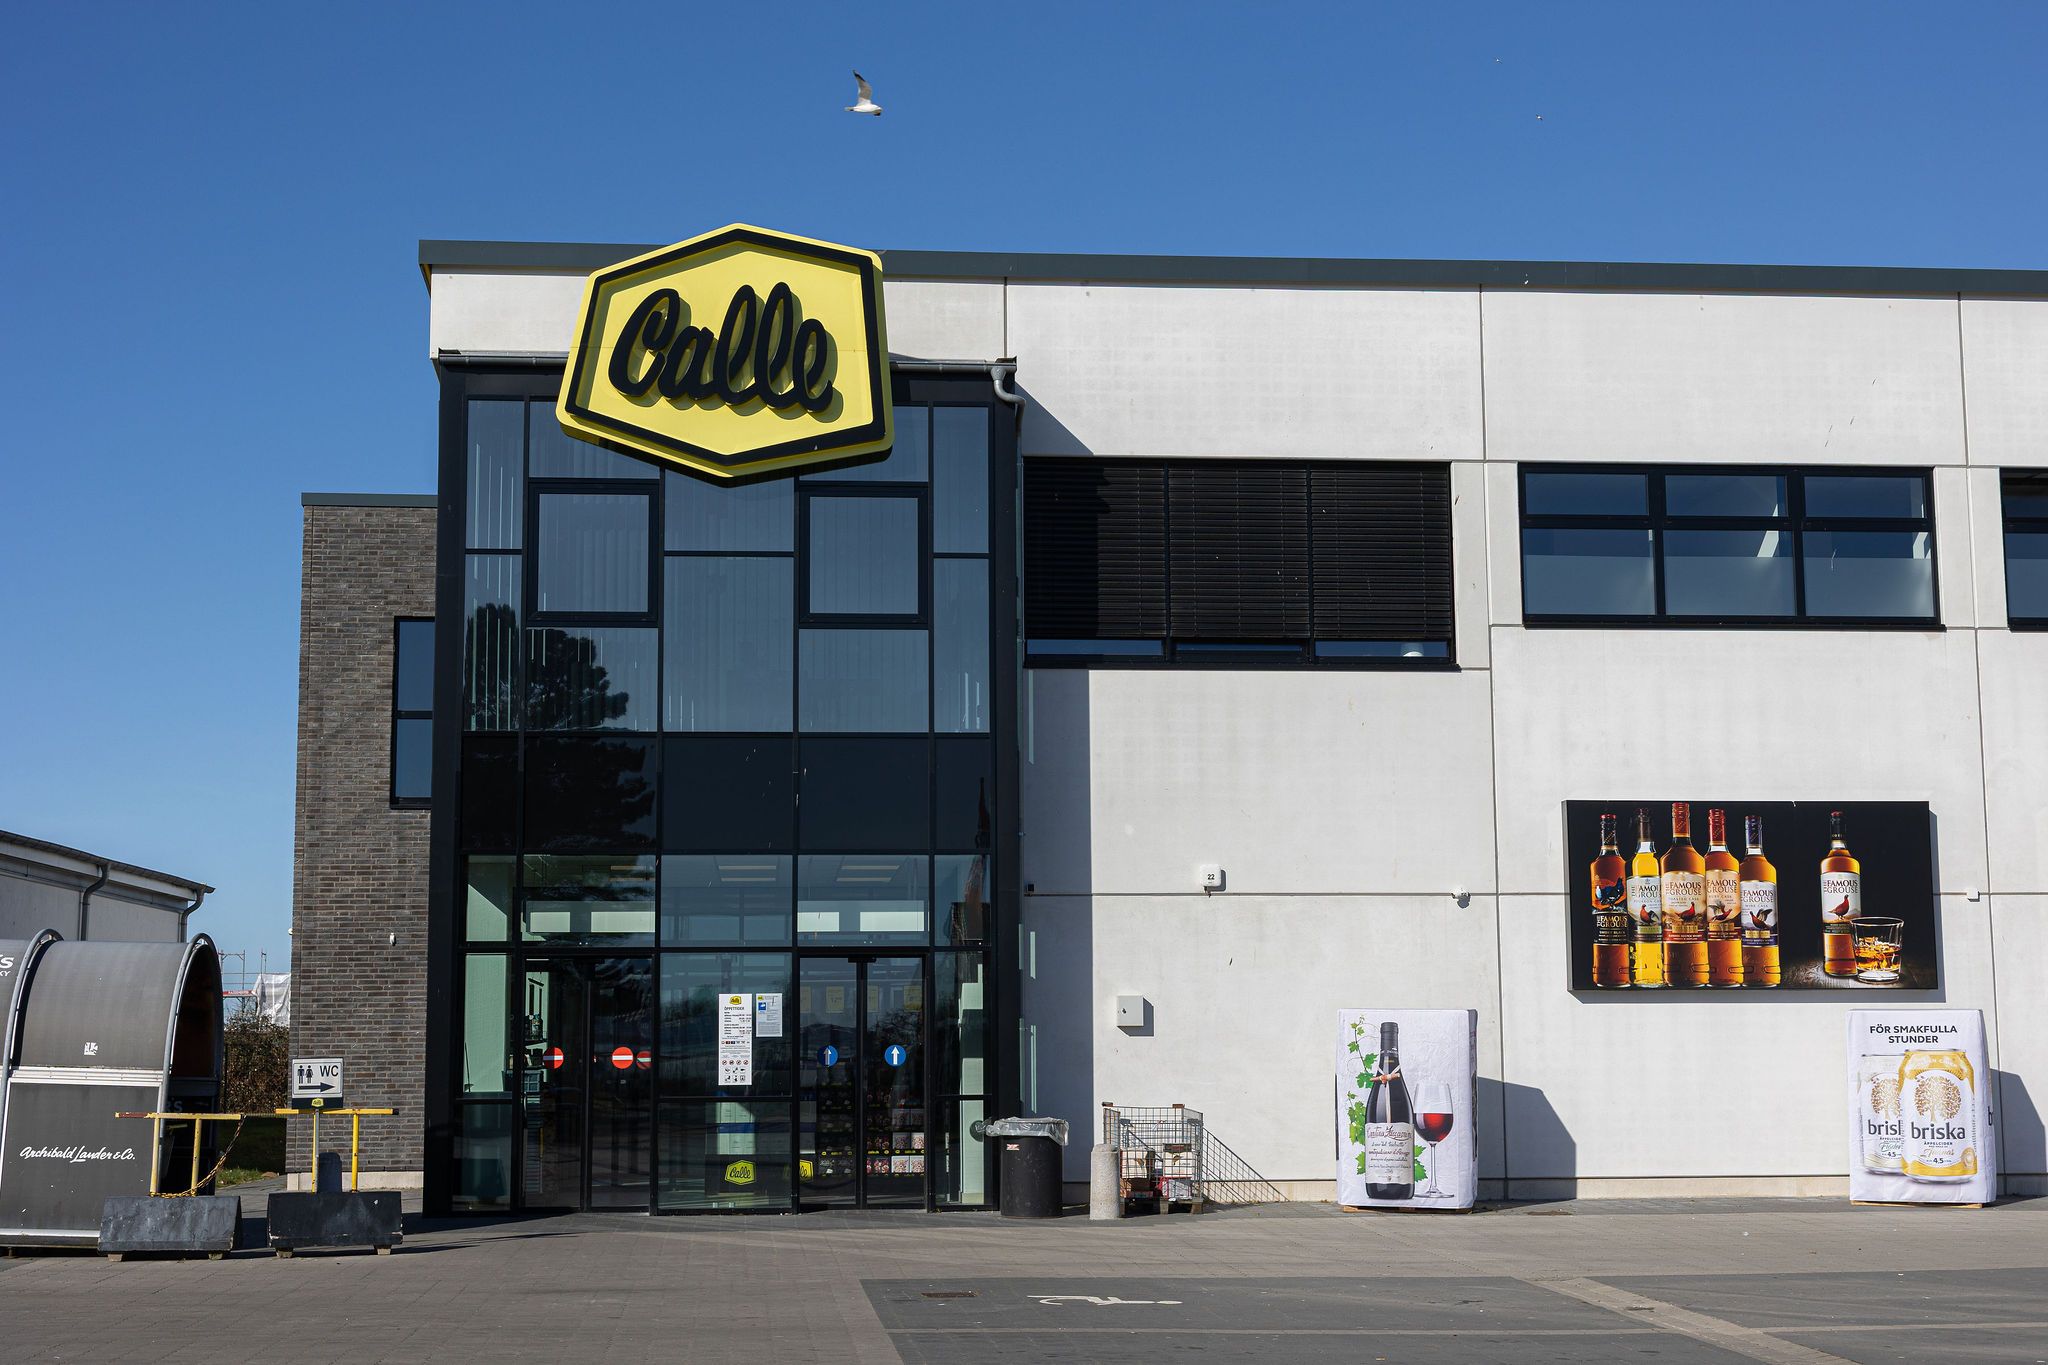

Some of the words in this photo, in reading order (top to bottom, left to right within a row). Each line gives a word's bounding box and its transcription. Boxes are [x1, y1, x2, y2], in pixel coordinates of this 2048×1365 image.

[608, 281, 833, 413] Calle
[1869, 1024, 1891, 1034] FÖR
[1893, 1025, 1958, 1034] SMAKFULLA
[1888, 1035, 1939, 1044] STUNDER
[319, 1065, 339, 1077] WC
[1911, 1121, 1966, 1140] briska
[20, 1146, 77, 1160] Archibald
[729, 1166, 752, 1179] Calle
